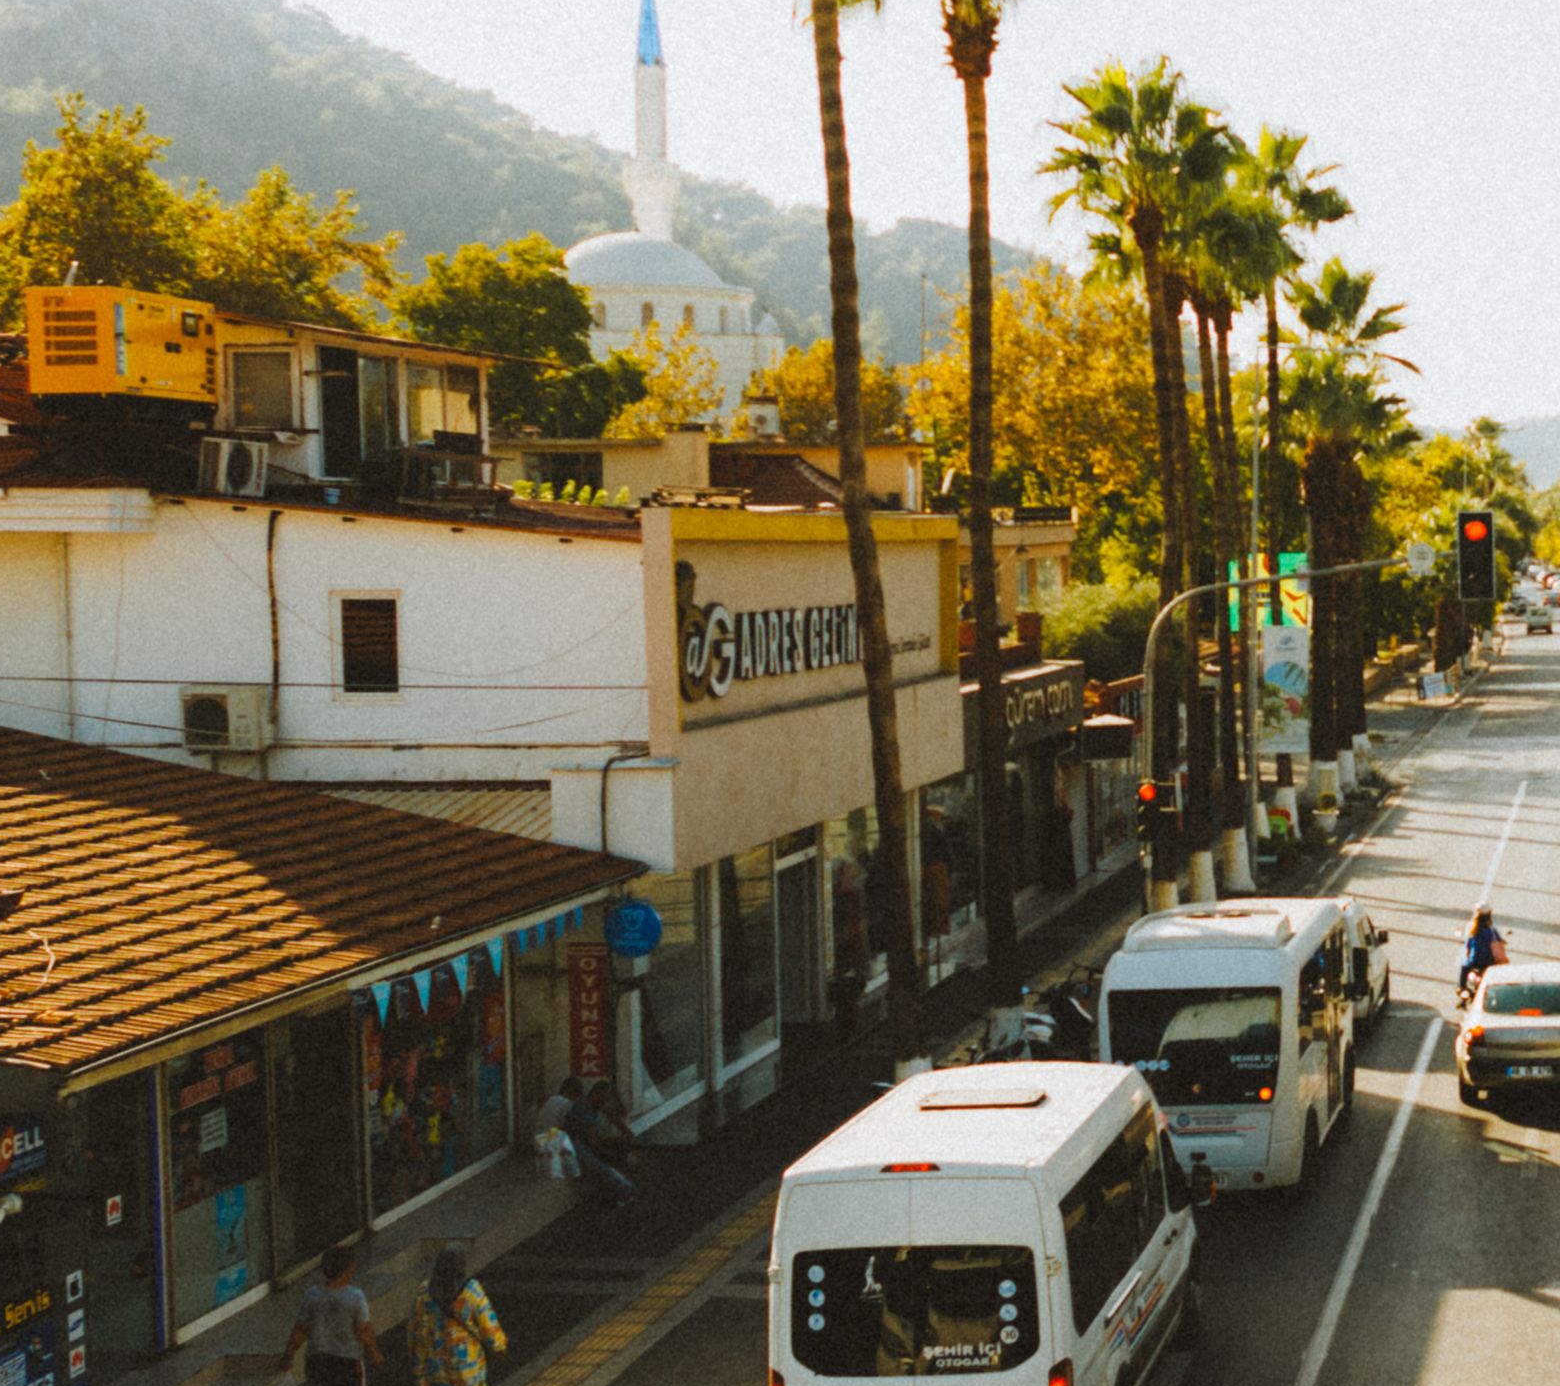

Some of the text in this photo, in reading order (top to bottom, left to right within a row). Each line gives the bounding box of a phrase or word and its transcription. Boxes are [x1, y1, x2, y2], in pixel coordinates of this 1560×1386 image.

[740, 611, 805, 680] ADRES
[579, 957, 600, 1074] OYUNCAK
[4, 1289, 52, 1329] Servis
[922, 1340, 1002, 1360] ŞEHİR İÇİ
